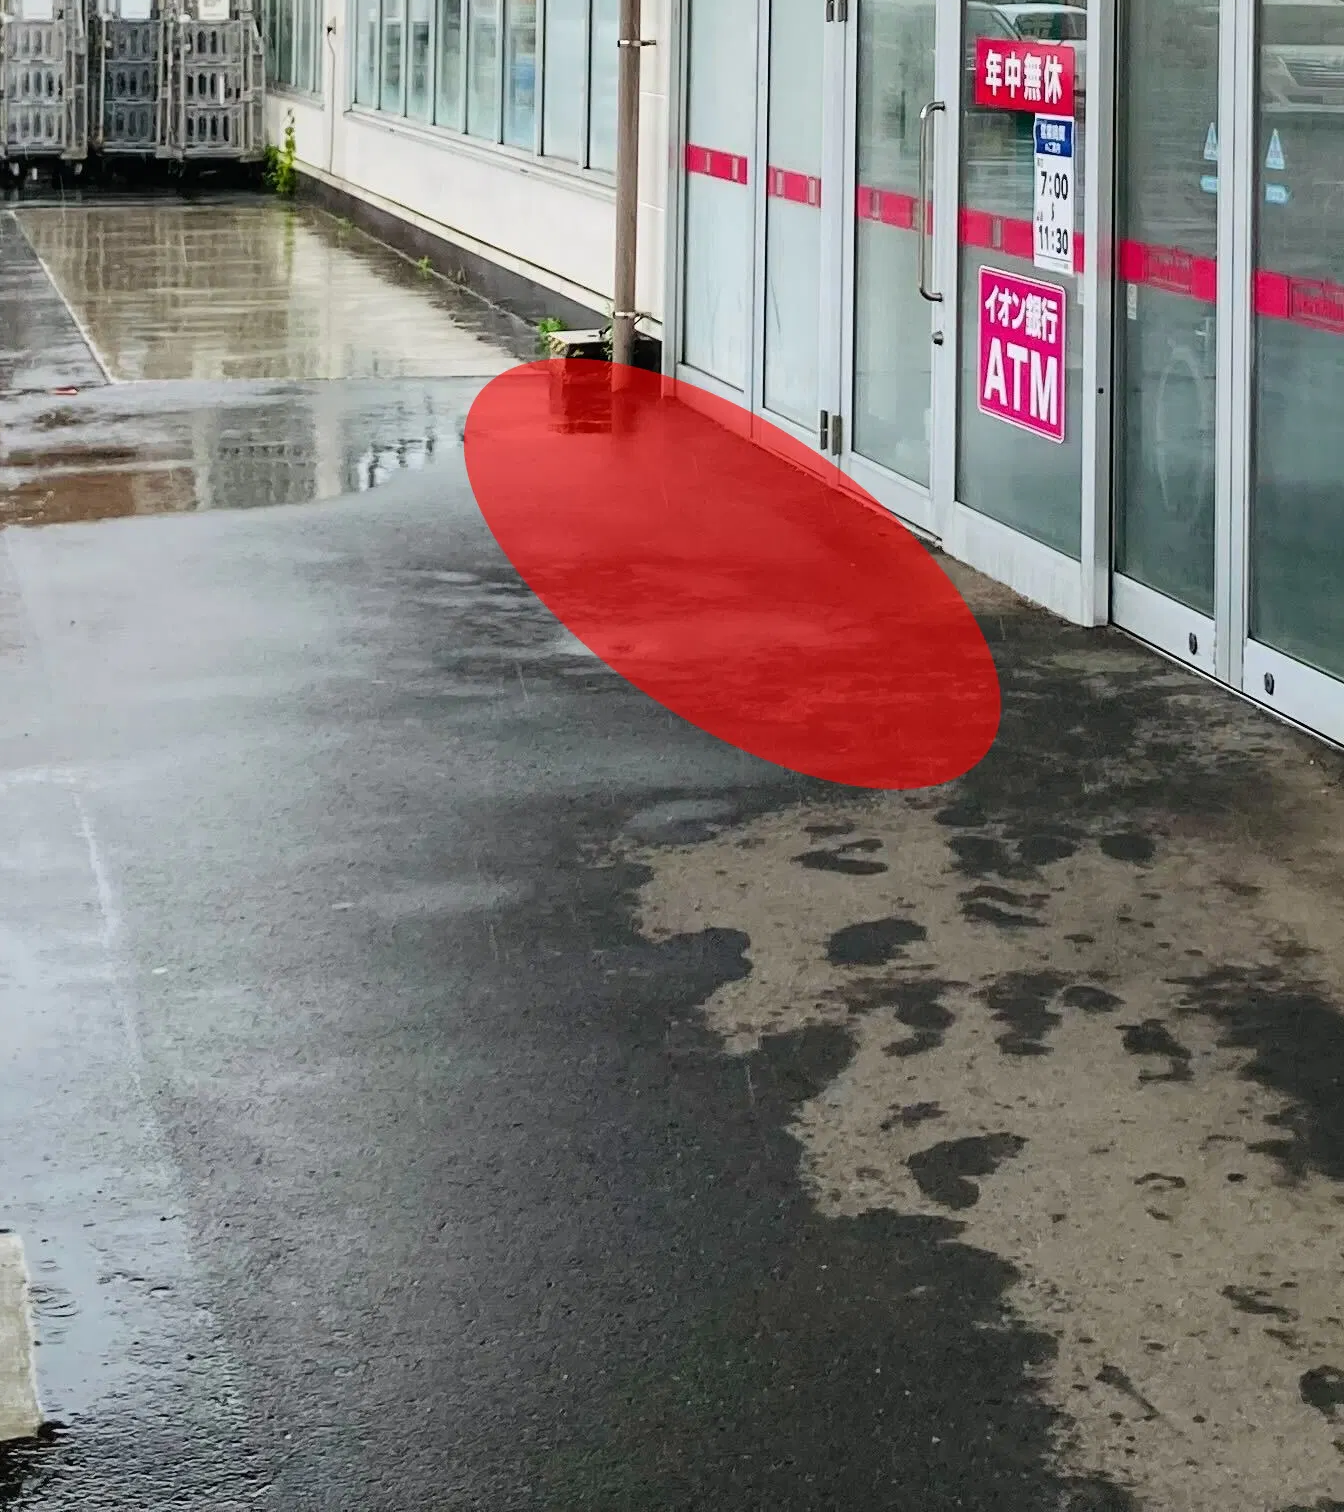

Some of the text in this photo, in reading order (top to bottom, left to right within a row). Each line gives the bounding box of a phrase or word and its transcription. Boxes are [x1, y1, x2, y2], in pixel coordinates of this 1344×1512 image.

[984, 49, 1064, 105] 年中無休
[1040, 171, 1069, 201] 7:00
[1038, 224, 1069, 256] 11:30
[984, 284, 1058, 346] イオン銀行
[983, 336, 1058, 427] ATM
